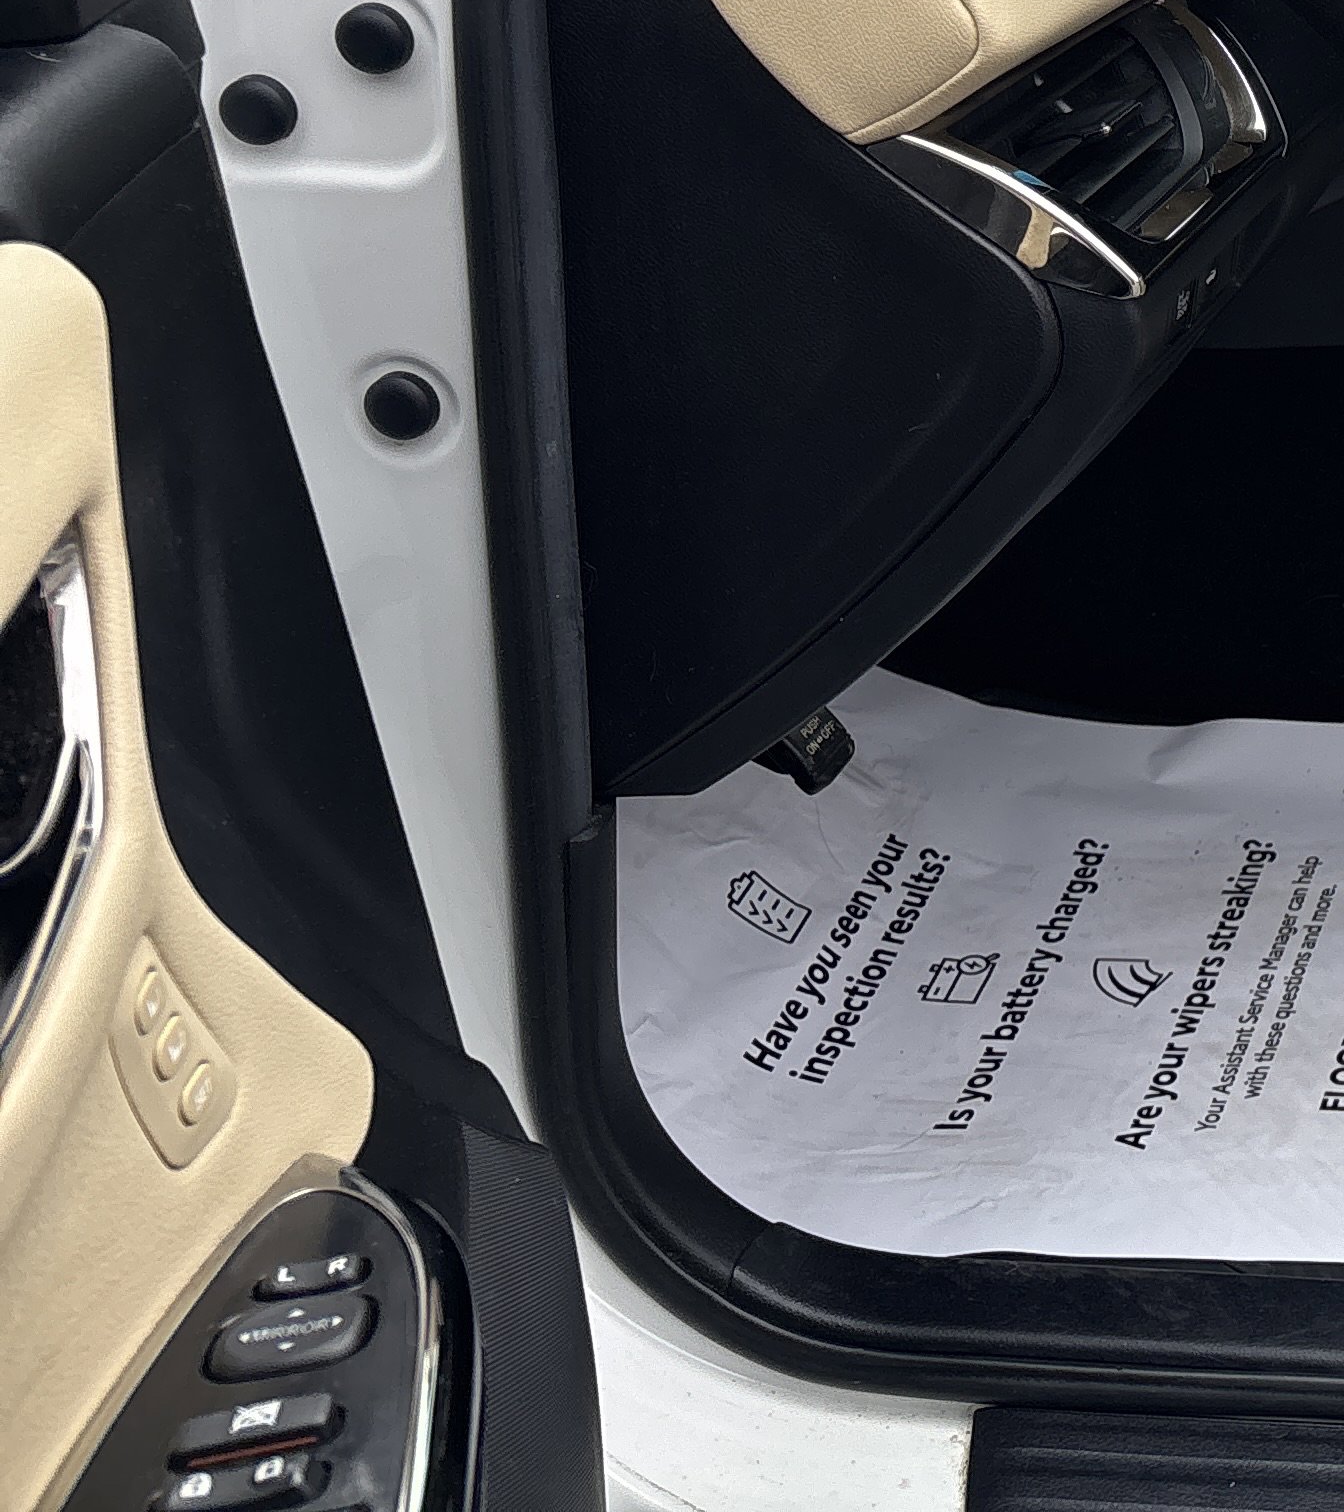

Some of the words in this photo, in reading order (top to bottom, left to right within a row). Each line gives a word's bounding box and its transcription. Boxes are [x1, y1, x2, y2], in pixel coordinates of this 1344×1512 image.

[801, 716, 820, 738] PUSH
[1036, 838, 1110, 943] charged?
[743, 999, 808, 1072] Have
[796, 944, 841, 1005] you
[831, 890, 877, 948] seen
[861, 833, 908, 893] your
[788, 948, 898, 1084] inspection
[882, 848, 951, 945] results?
[980, 948, 1063, 1040] battery
[1115, 1105, 1162, 1150] Are
[1144, 1043, 1189, 1100] your
[1171, 957, 1226, 1038] wipers
[1207, 840, 1277, 951] streaking?
[1195, 1097, 1227, 1132] Your
[1212, 1028, 1255, 1095] Assistant
[1240, 974, 1274, 1024] Service
[1259, 913, 1297, 971] Manager
[1288, 881, 1307, 911] can
[1299, 855, 1323, 885] help
[1244, 1065, 1265, 1100] with
[1255, 1022, 1286, 1063] these
[1276, 950, 1311, 1021] questions
[1302, 925, 1322, 950] and
[1312, 884, 1338, 922] more.
[933, 1108, 974, 1130] Is
[957, 1047, 1007, 1103] your
[277, 1266, 295, 1283] L
[327, 1257, 348, 1275] R
